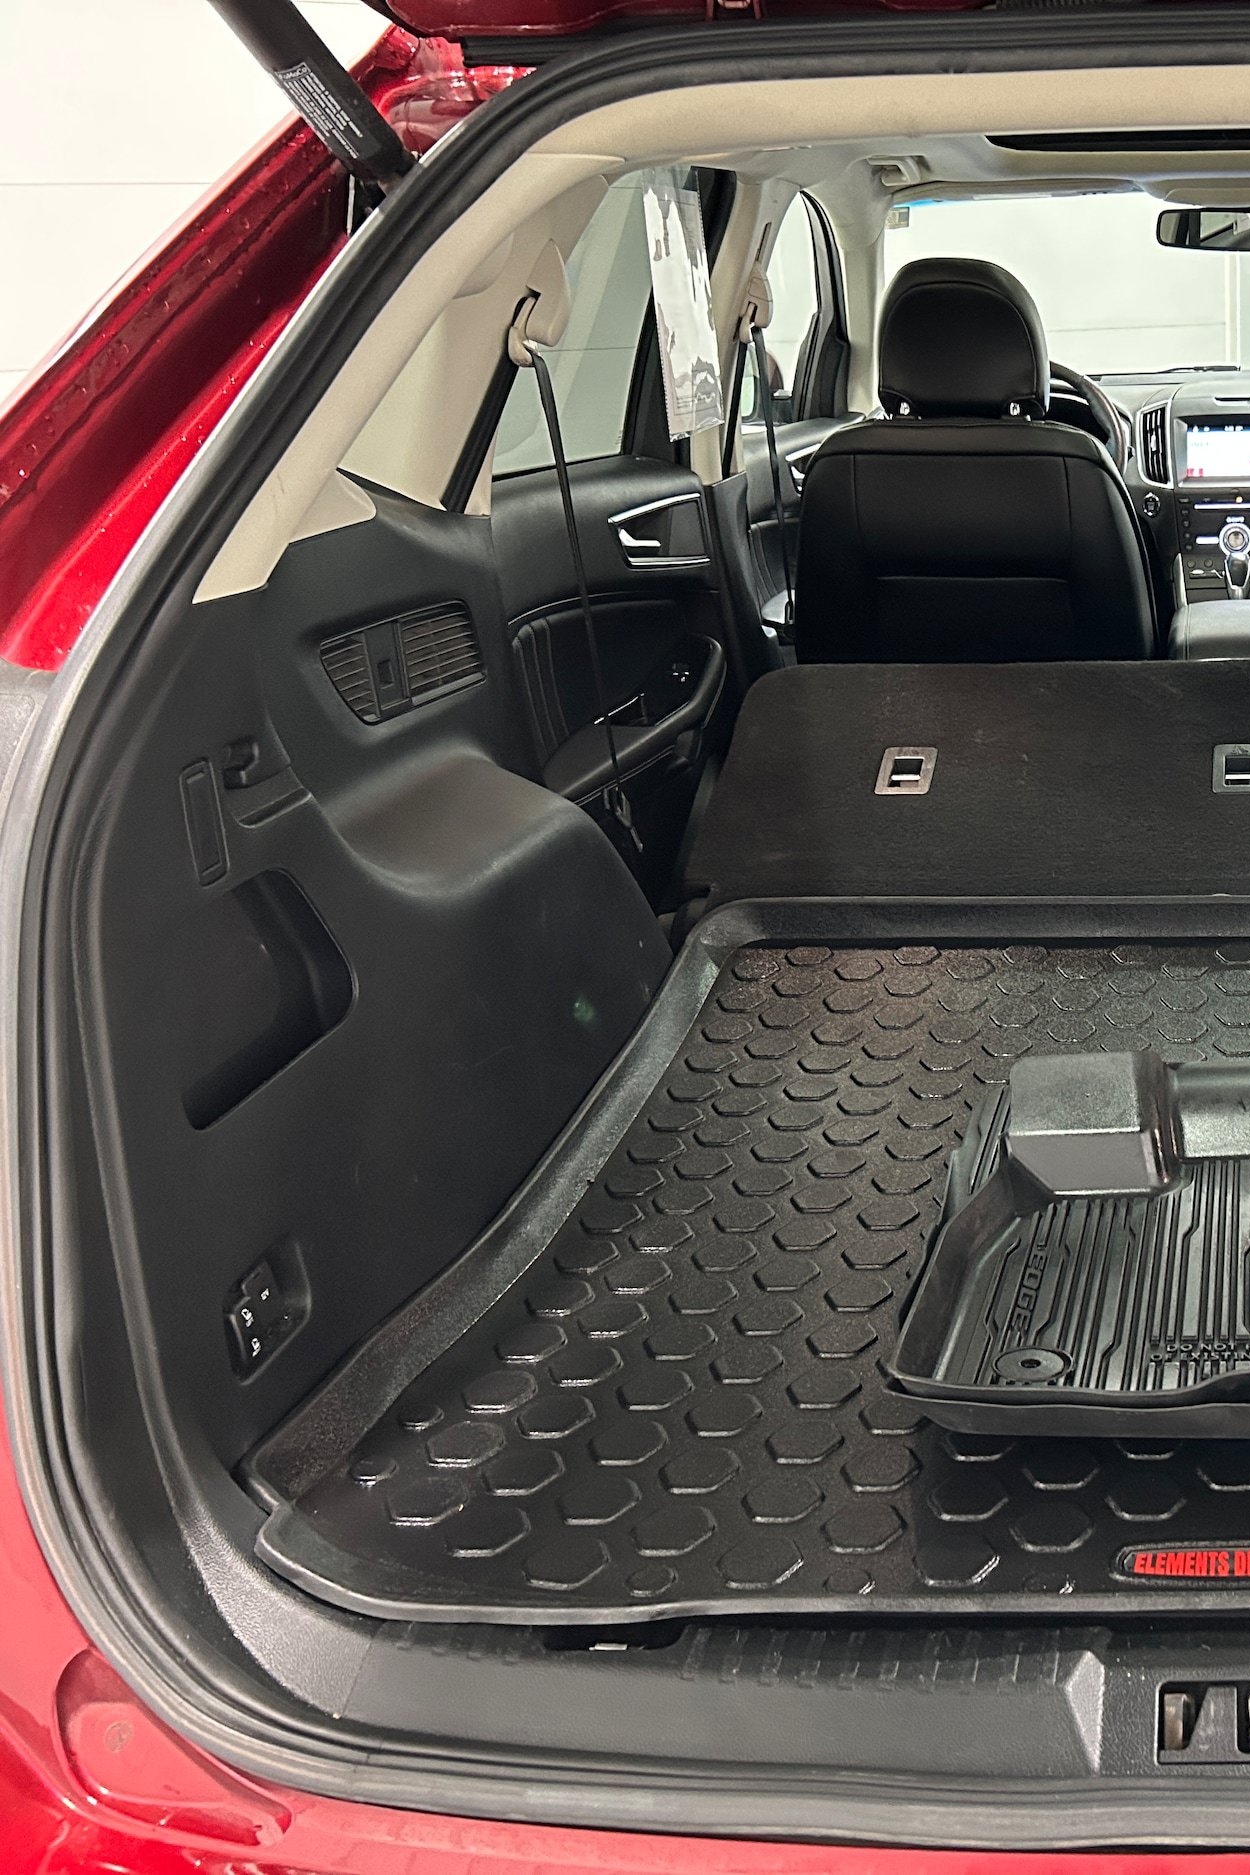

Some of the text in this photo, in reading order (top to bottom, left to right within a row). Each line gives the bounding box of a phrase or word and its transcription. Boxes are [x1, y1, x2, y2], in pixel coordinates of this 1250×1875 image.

[1010, 1251, 1048, 1333] EDGE
[1166, 1343, 1193, 1352] DO
[1200, 1343, 1235, 1351] NOT
[1150, 1353, 1172, 1361] OF
[1133, 1551, 1230, 1577] ELEMENTS
